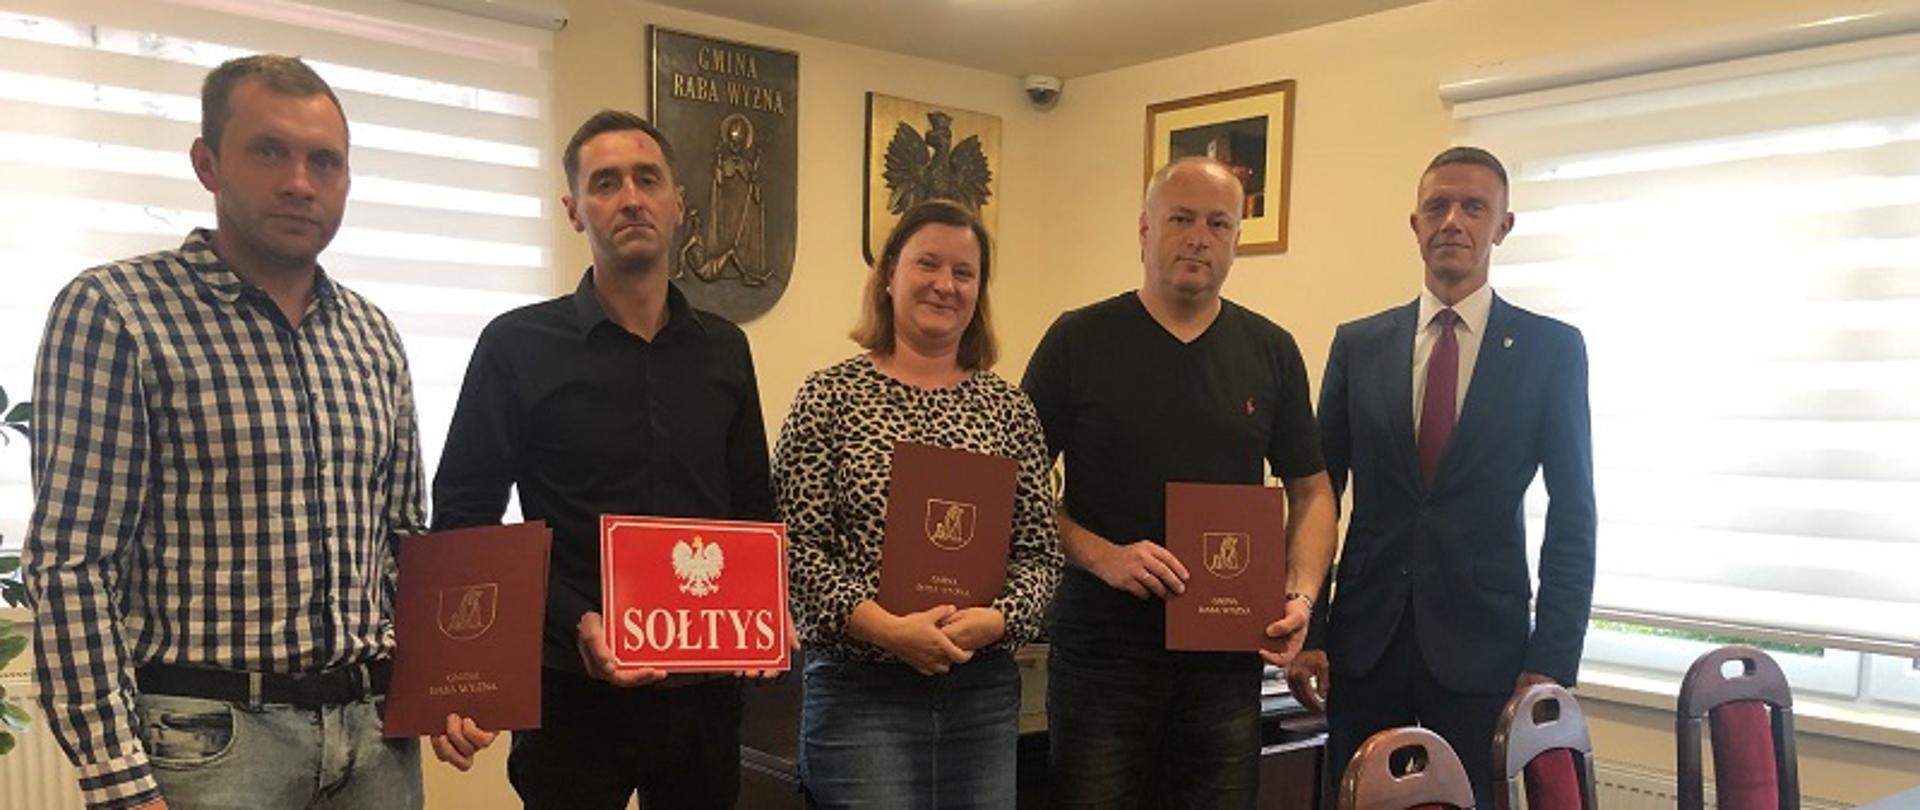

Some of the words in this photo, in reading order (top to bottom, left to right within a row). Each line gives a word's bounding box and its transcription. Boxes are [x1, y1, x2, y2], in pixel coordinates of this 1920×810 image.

[698, 46, 758, 79] GMINA
[673, 72, 719, 102] RABA
[623, 607, 775, 651] SOŁTYS
